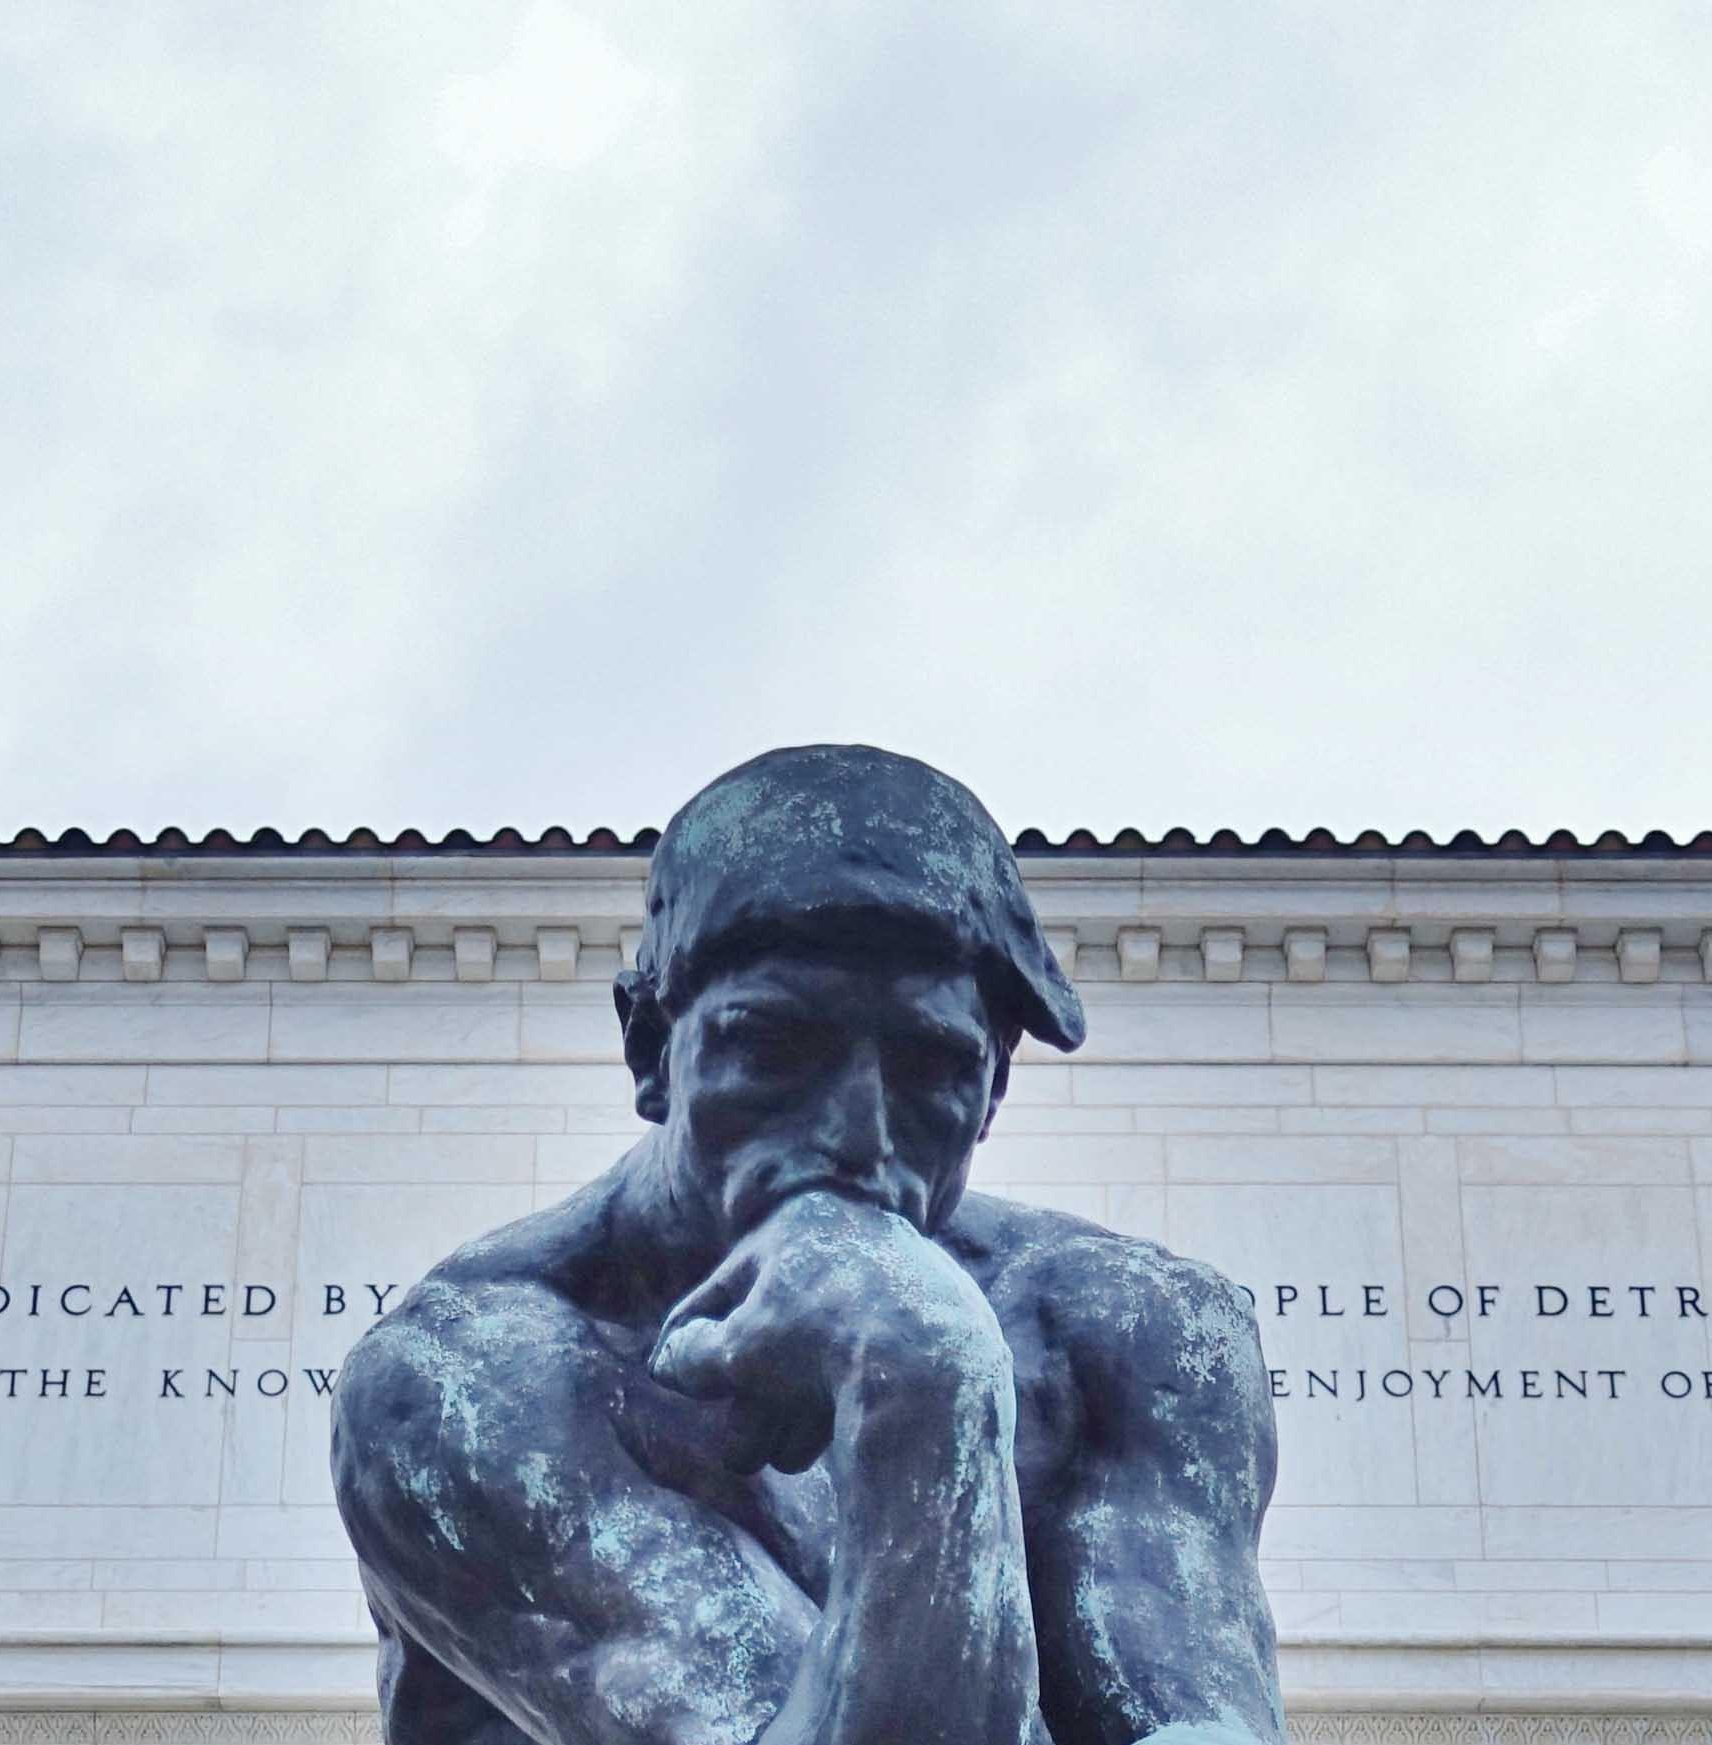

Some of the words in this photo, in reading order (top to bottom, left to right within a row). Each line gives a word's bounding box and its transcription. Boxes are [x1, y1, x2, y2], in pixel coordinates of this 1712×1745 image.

[322, 1284, 398, 1316] BY
[1428, 1285, 1500, 1319] OF
[0, 1368, 107, 1398] THE
[1268, 1369, 1627, 1402] ENJOYMENT
